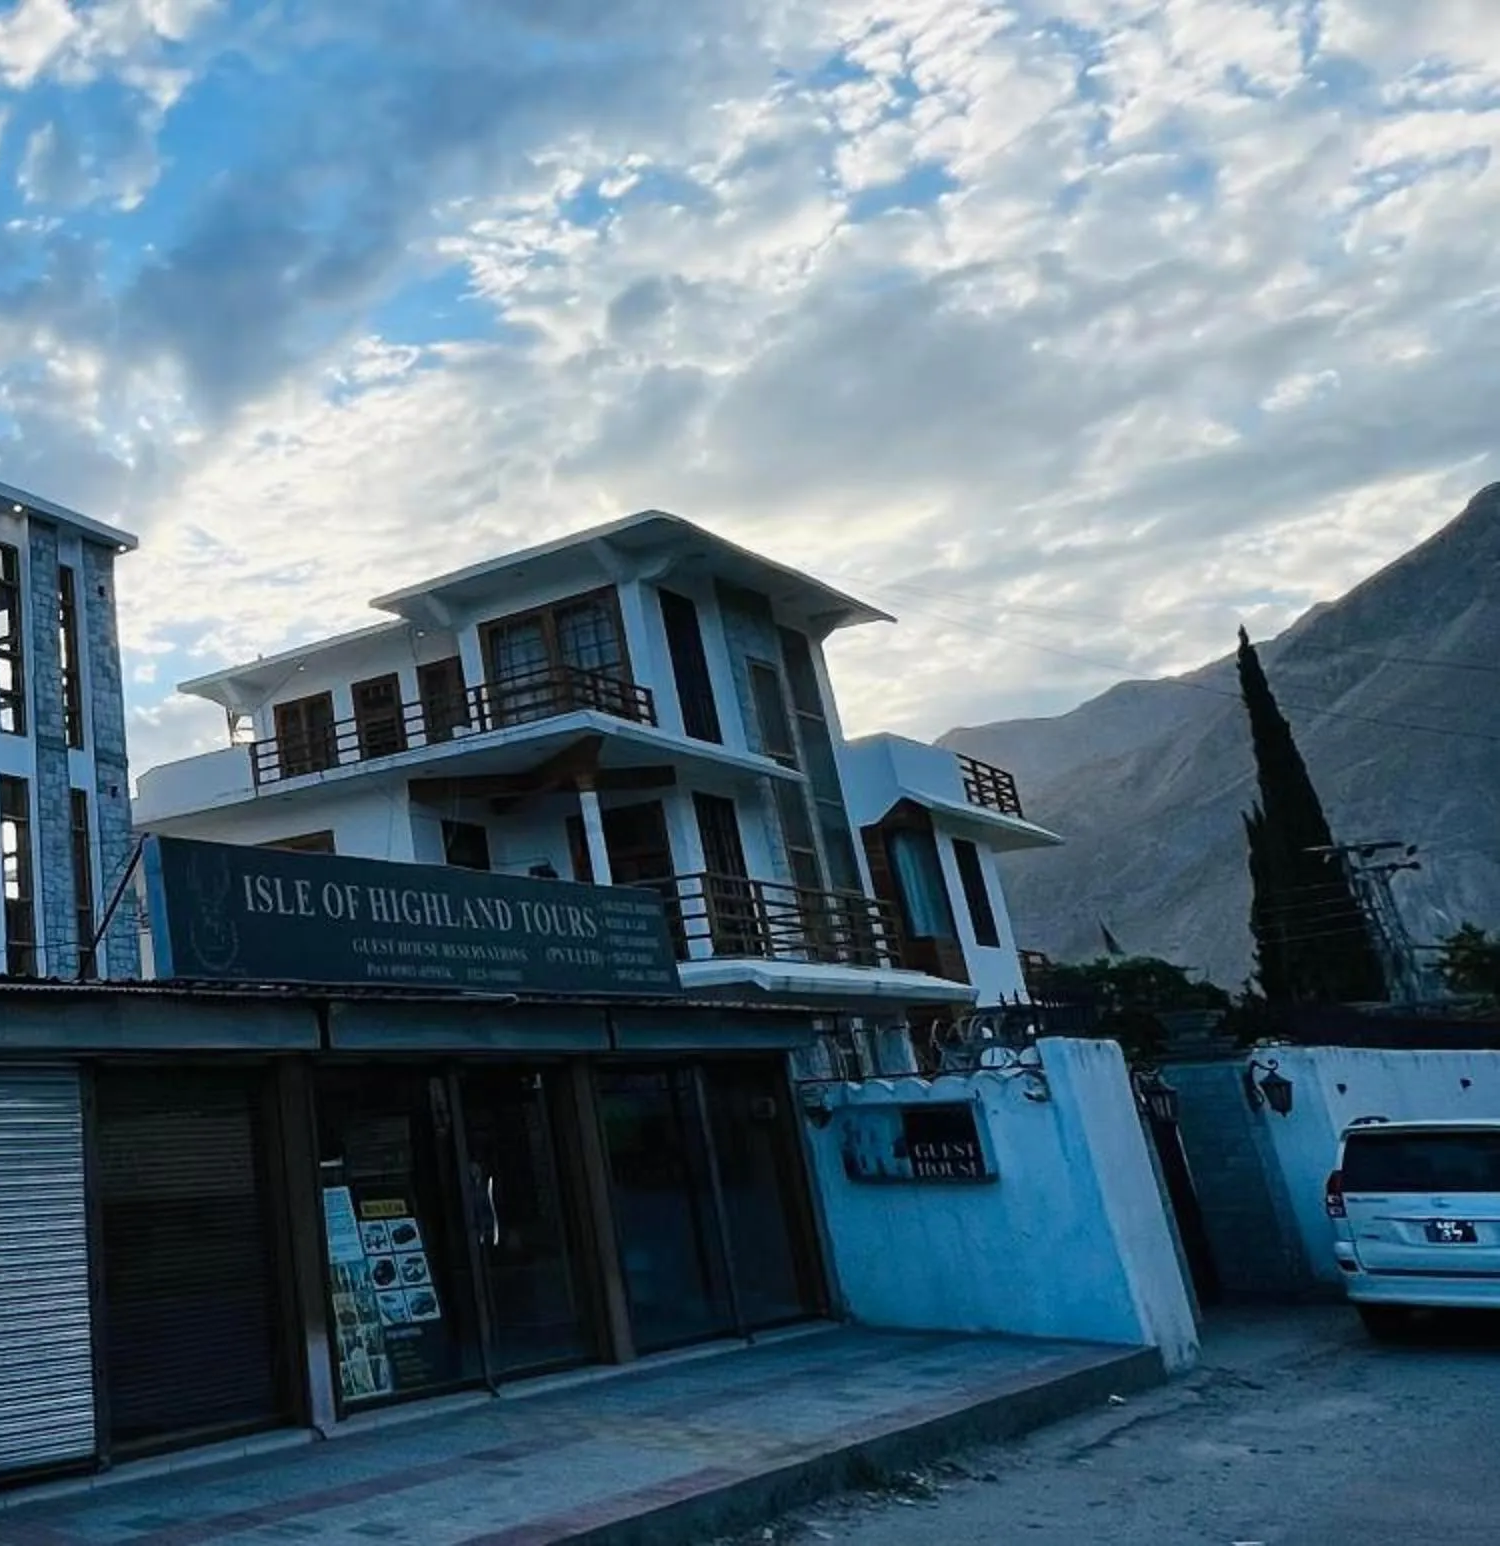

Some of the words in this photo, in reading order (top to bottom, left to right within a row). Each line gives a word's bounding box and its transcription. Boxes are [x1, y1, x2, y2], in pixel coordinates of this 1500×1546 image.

[243, 874, 316, 917] ISLE
[321, 880, 361, 921] OF
[367, 886, 514, 932] HIGHLAND
[517, 899, 599, 940] TOURS
[352, 937, 395, 956] GUEST
[913, 1141, 975, 1160] GUEST
[915, 1159, 977, 1177] HOUSE
